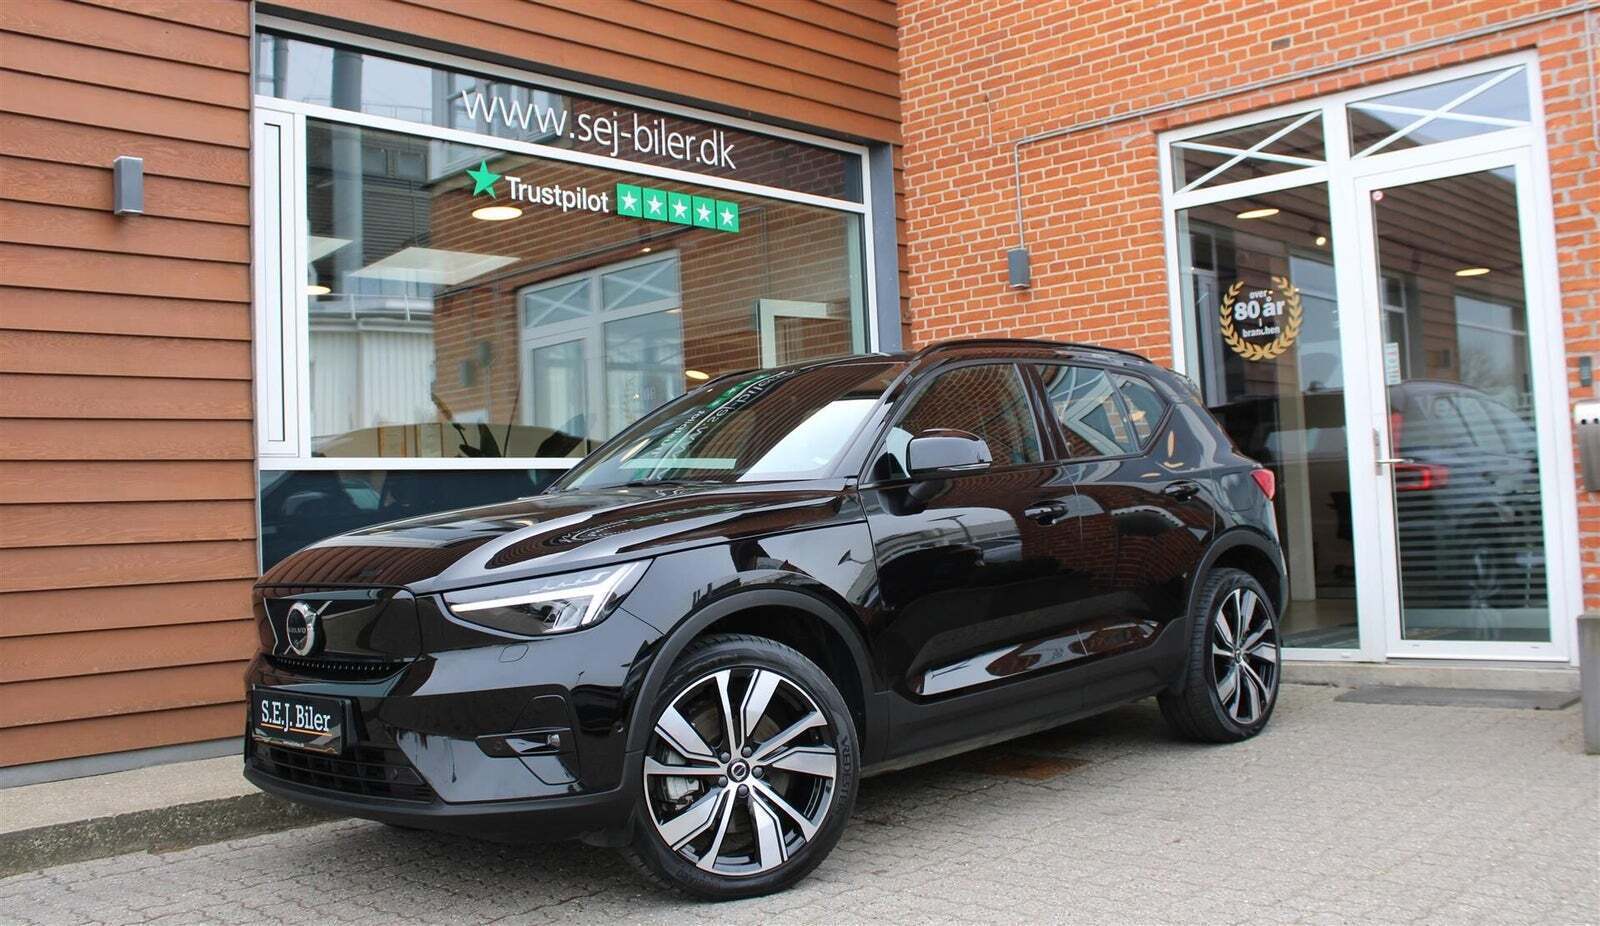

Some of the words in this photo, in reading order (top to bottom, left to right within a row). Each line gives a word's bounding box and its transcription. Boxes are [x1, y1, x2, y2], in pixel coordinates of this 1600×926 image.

[462, 89, 736, 170] www.sej-biler.dk
[505, 176, 610, 213] Trustpilot
[1234, 300, 1260, 321] 80
[1262, 296, 1286, 317] år
[1249, 290, 1267, 299] over
[1242, 326, 1280, 337] branchen
[261, 700, 293, 732] S.E.J.
[295, 704, 331, 731] Biler
